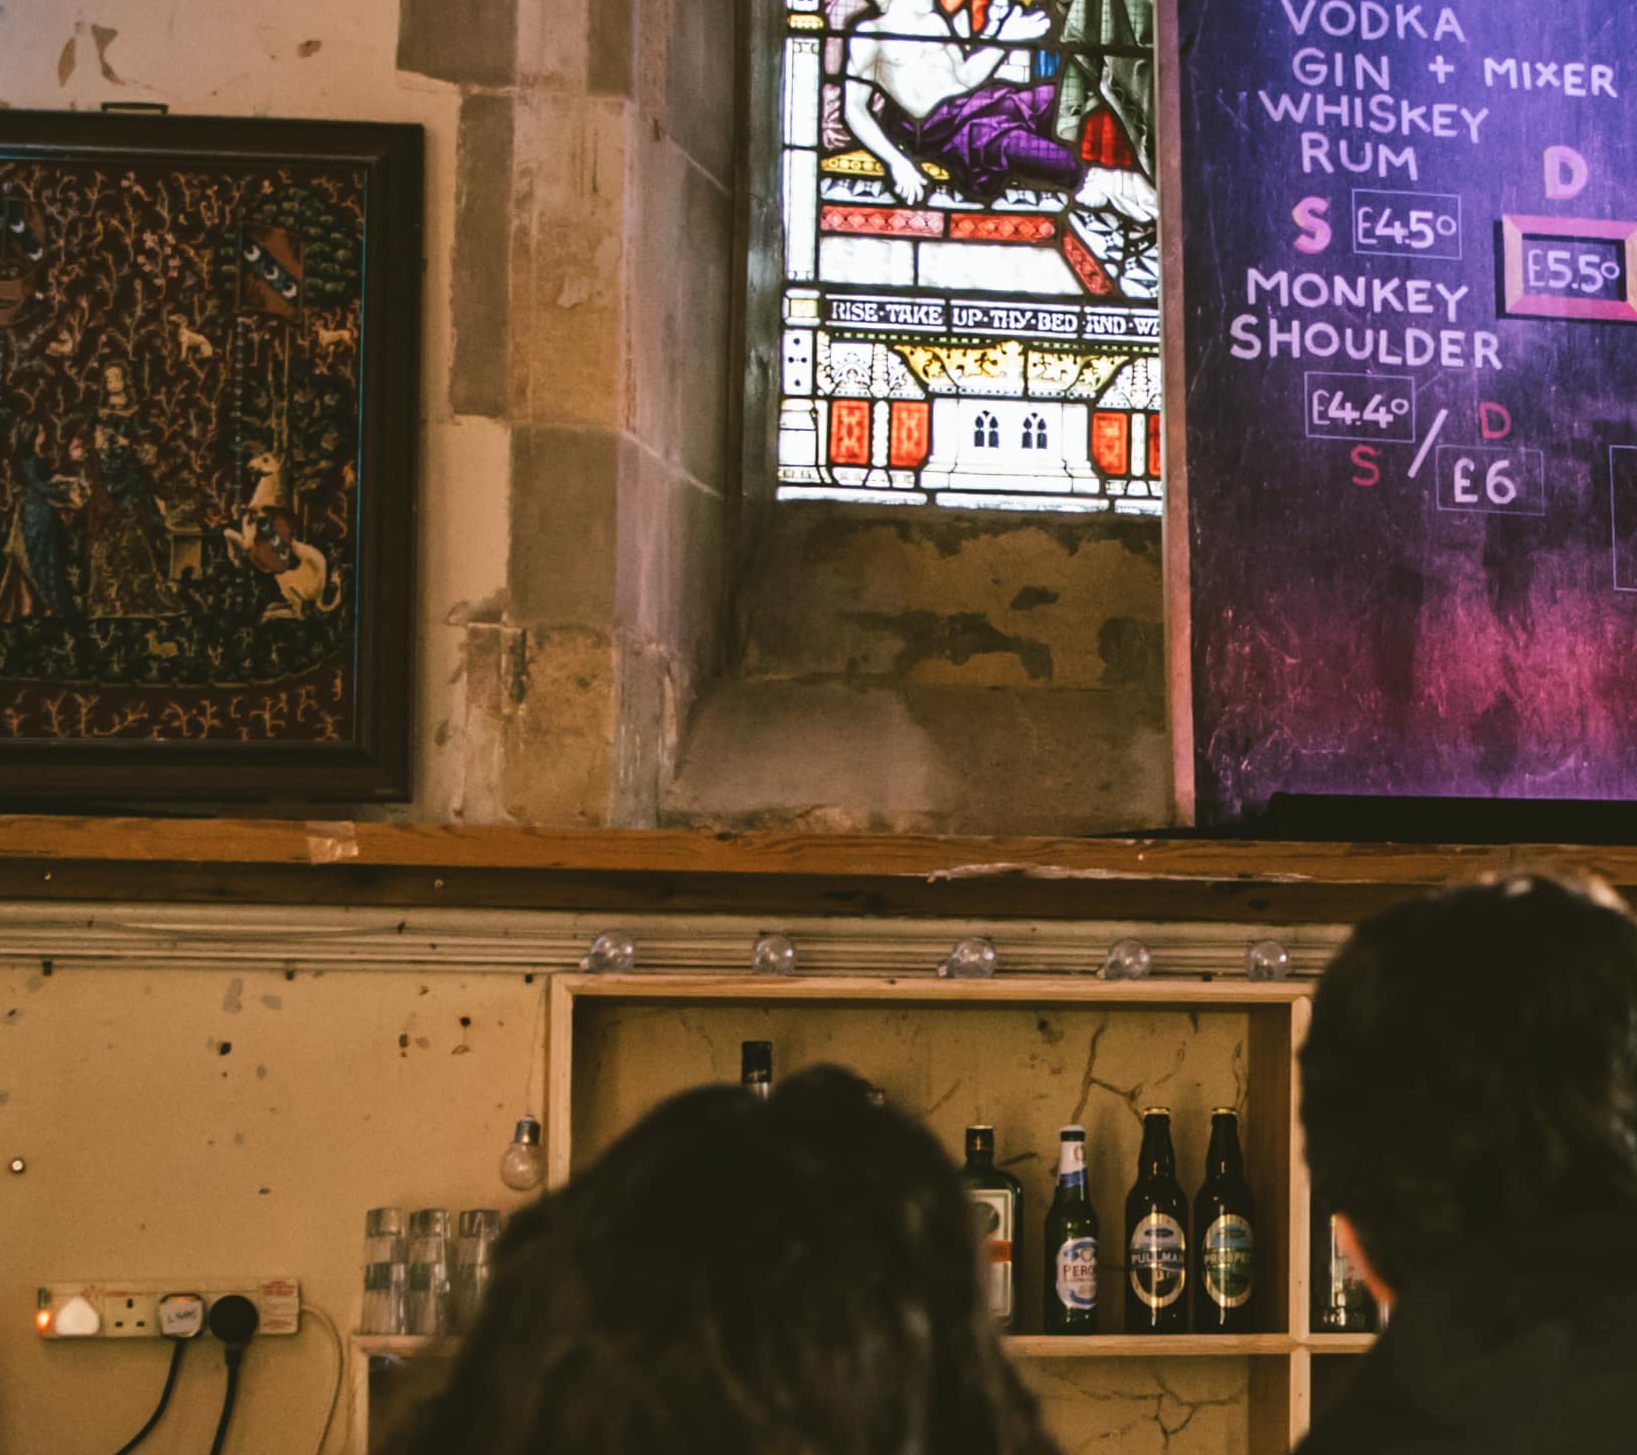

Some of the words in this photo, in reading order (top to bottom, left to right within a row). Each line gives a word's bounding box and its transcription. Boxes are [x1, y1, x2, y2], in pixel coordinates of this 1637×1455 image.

[1291, 47, 1391, 92] GIN
[1483, 57, 1619, 99] MIXER
[1257, 89, 1489, 145] WHISKEY
[1299, 131, 1420, 182] RUM
[1542, 145, 1589, 201] D
[1292, 195, 1333, 255] S
[831, 300, 878, 322] RISE
[886, 303, 943, 327] TAKE
[952, 307, 982, 328] UP
[989, 309, 1032, 330] THY
[1036, 312, 1078, 334] BED
[1086, 315, 1126, 335] AND
[1245, 267, 1470, 322] MONKEY
[1229, 313, 1504, 371] SHOULDER
[1478, 401, 1512, 440] D
[1351, 444, 1381, 487] S
[1452, 457, 1519, 506] £6
[1063, 1263, 1095, 1280] PERO
